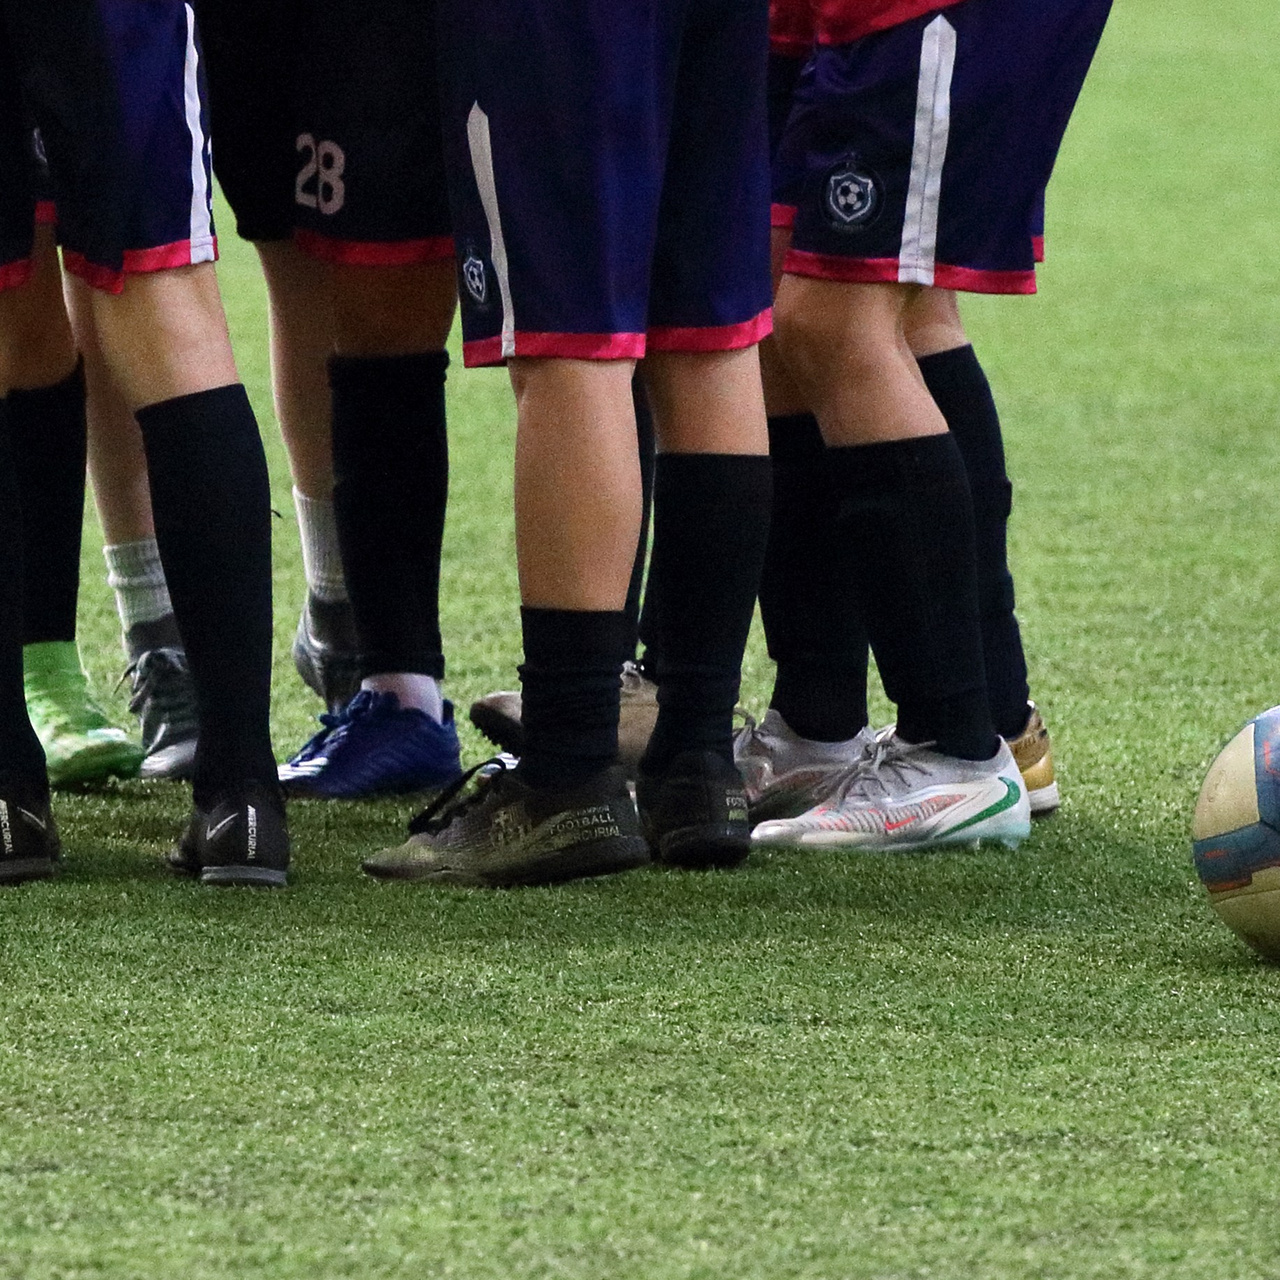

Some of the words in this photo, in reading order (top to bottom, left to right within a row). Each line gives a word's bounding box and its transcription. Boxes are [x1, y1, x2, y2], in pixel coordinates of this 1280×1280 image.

[295, 132, 345, 215] 28
[247, 804, 257, 859] MERCURIAL
[549, 813, 615, 835] FOOTBALL
